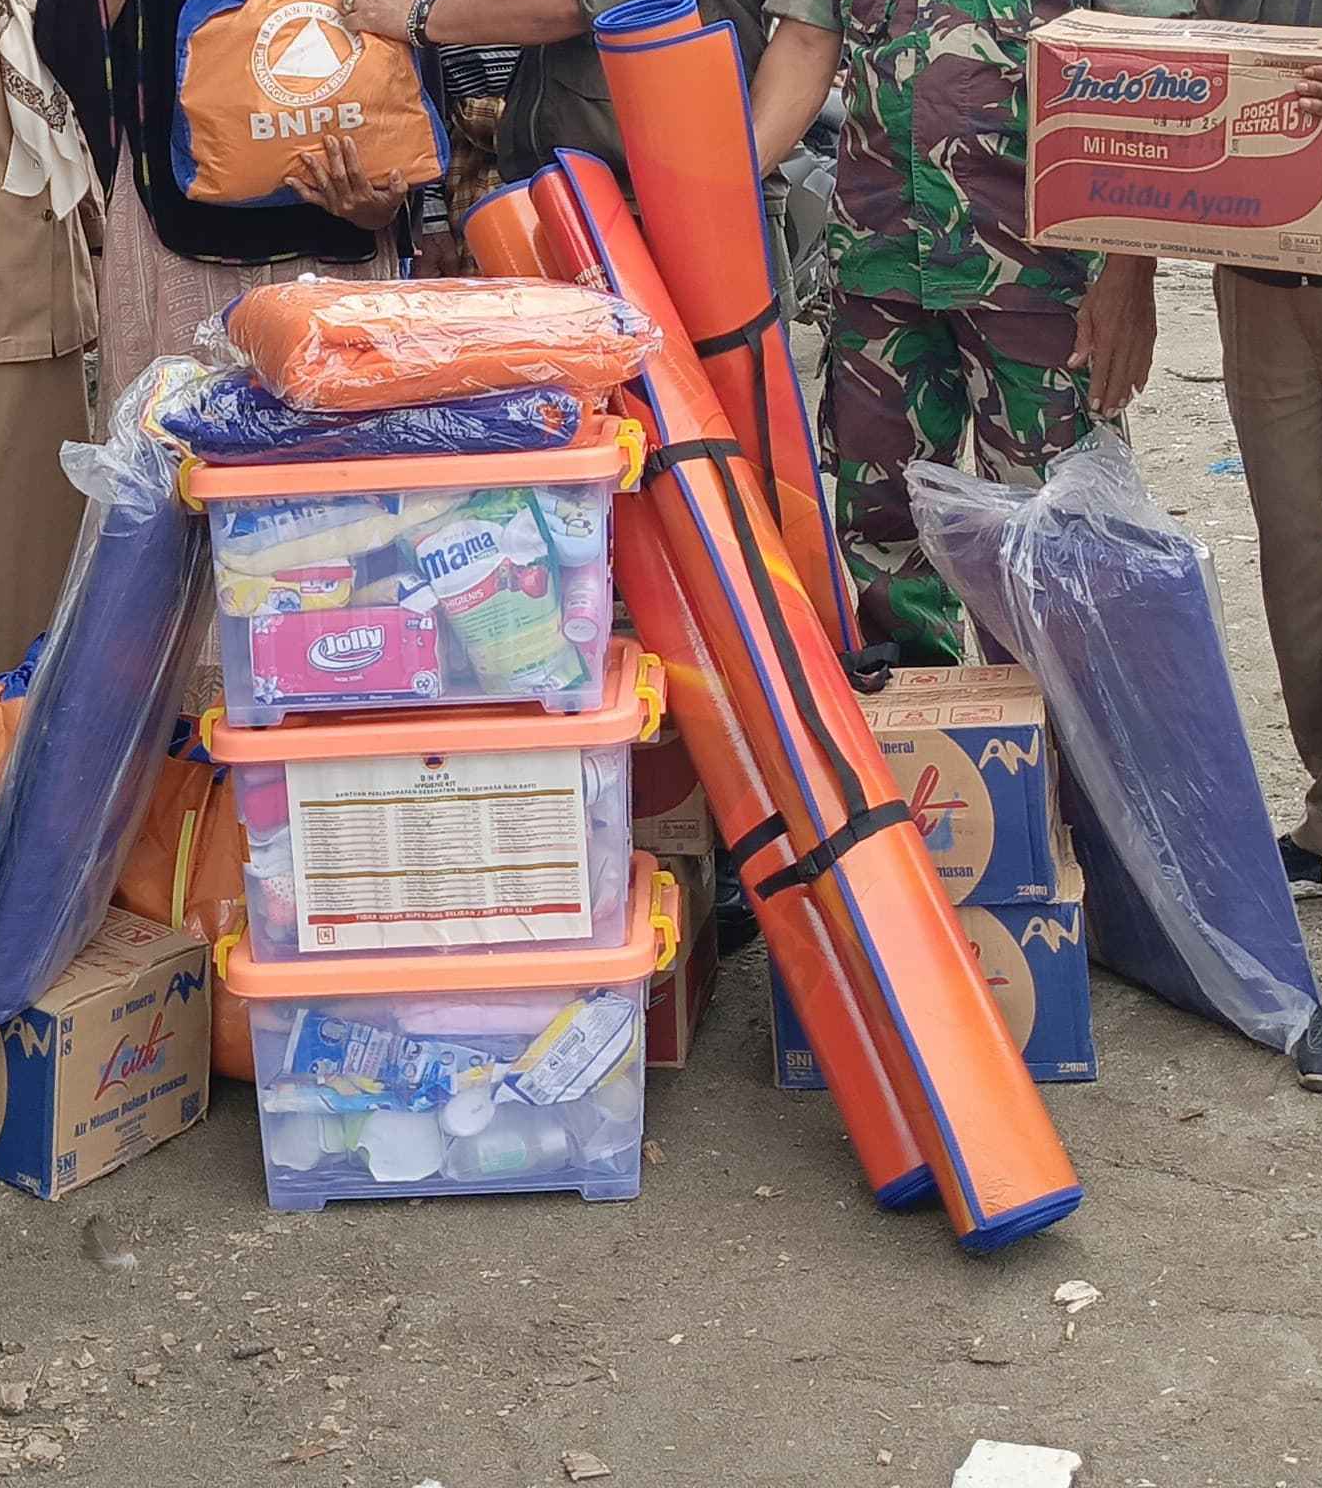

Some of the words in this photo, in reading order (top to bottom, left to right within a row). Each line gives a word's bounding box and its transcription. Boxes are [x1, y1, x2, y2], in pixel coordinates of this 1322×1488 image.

[250, 102, 365, 140] BNPB
[1243, 101, 1279, 120] PORSI
[1235, 117, 1280, 134] EKSTRA
[1083, 135, 1106, 154] Mi
[1110, 136, 1168, 160] Instan
[1088, 180, 1170, 209] Kaldu
[1179, 185, 1261, 220] Ayam
[421, 531, 496, 582] mama
[326, 627, 383, 655] Jolly
[111, 1007, 124, 1023] Air
[125, 990, 157, 1016] Mineral
[786, 1052, 813, 1067] SNI
[74, 1120, 87, 1138] Air
[89, 1107, 119, 1132] Minum
[121, 1093, 148, 1116] Dalam
[150, 1073, 188, 1100] Kemasan
[57, 1152, 77, 1173] SNI
